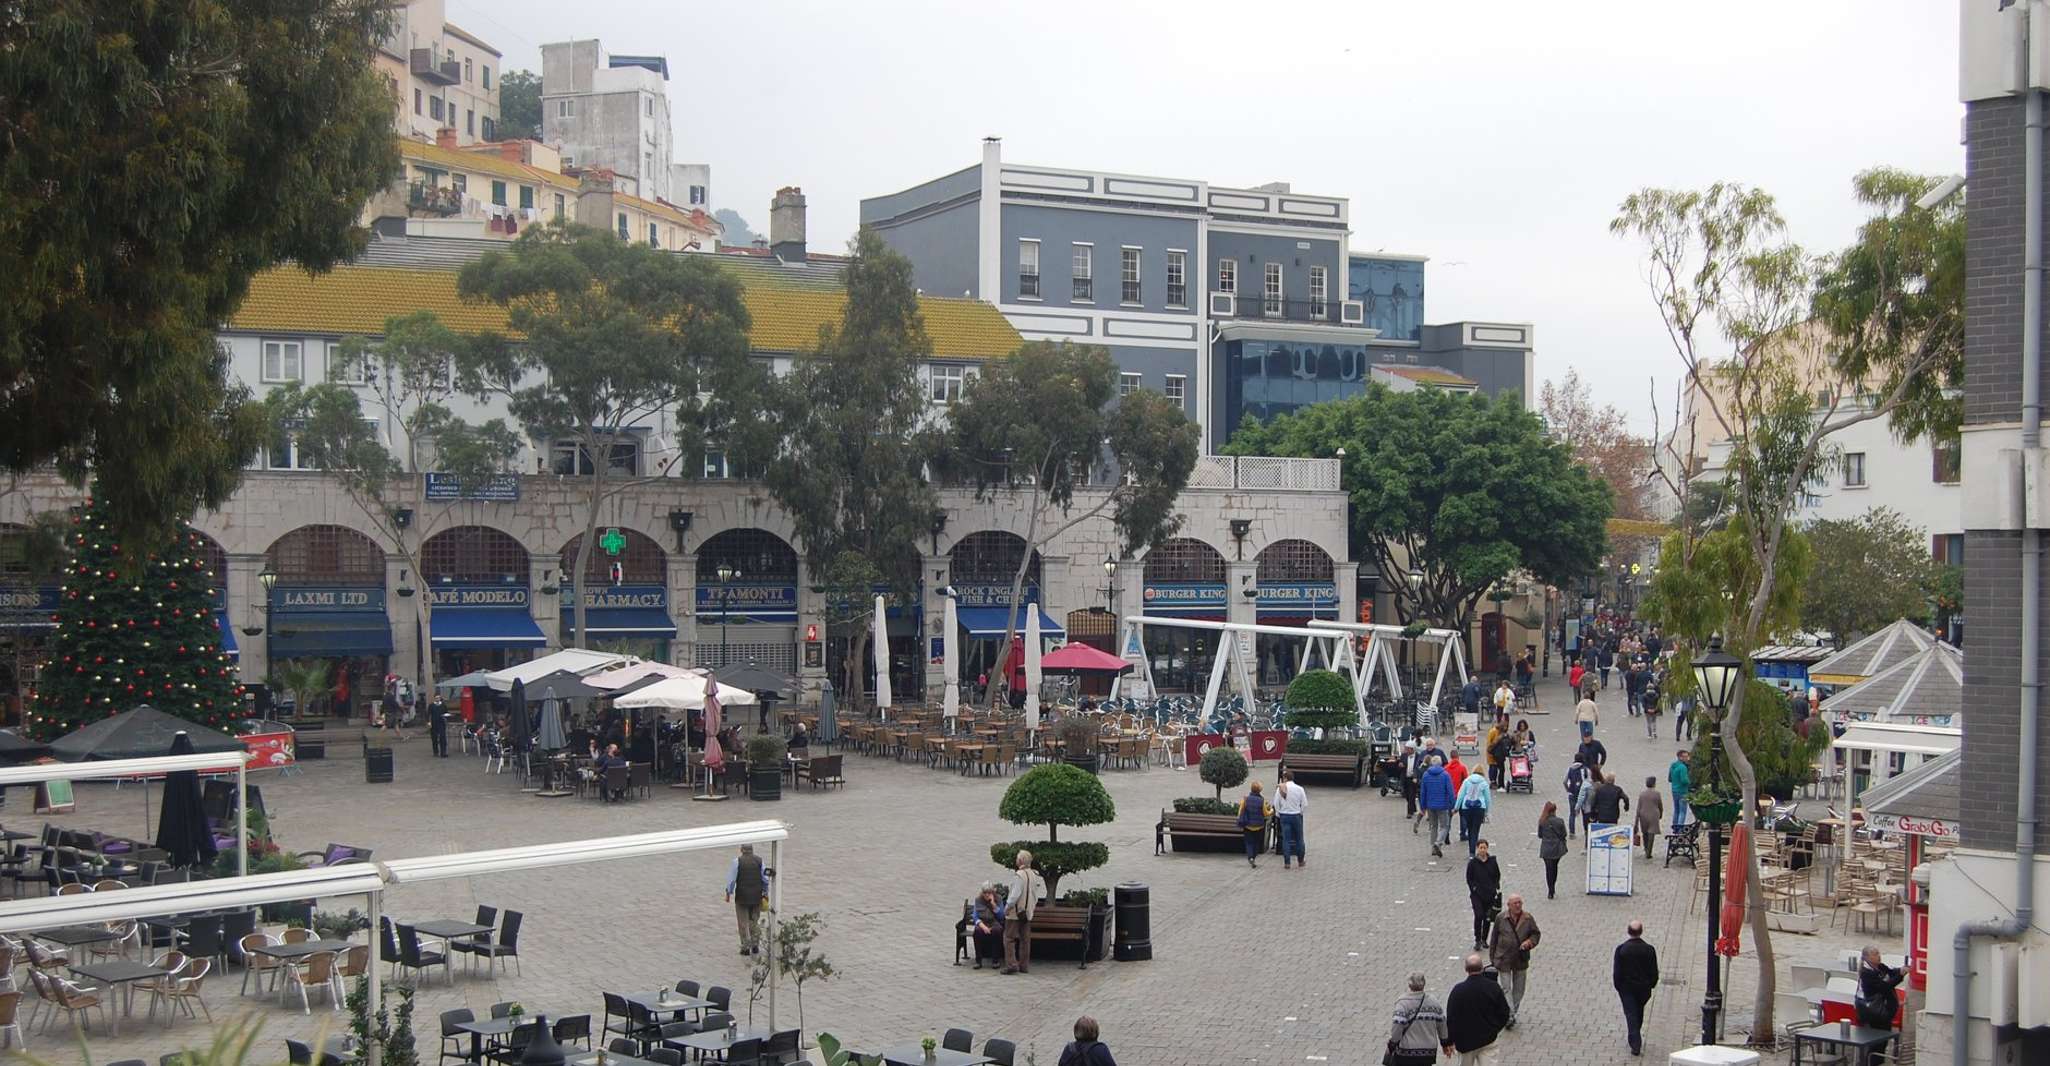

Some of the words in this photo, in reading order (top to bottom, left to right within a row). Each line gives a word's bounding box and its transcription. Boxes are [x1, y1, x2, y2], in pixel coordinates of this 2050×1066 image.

[462, 590, 526, 604] MODELO
[988, 586, 1028, 597] ENGLH
[1155, 589, 1197, 599] BURGER
[1199, 589, 1226, 599] KING
[1304, 588, 1334, 599] KING
[285, 592, 336, 605] LAXMI
[341, 592, 368, 605] LTD
[583, 593, 663, 608] HARMACY
[961, 595, 983, 604] FISH
[985, 595, 993, 604] &
[995, 595, 1025, 604] CHIS
[1872, 815, 1896, 828] Coffee
